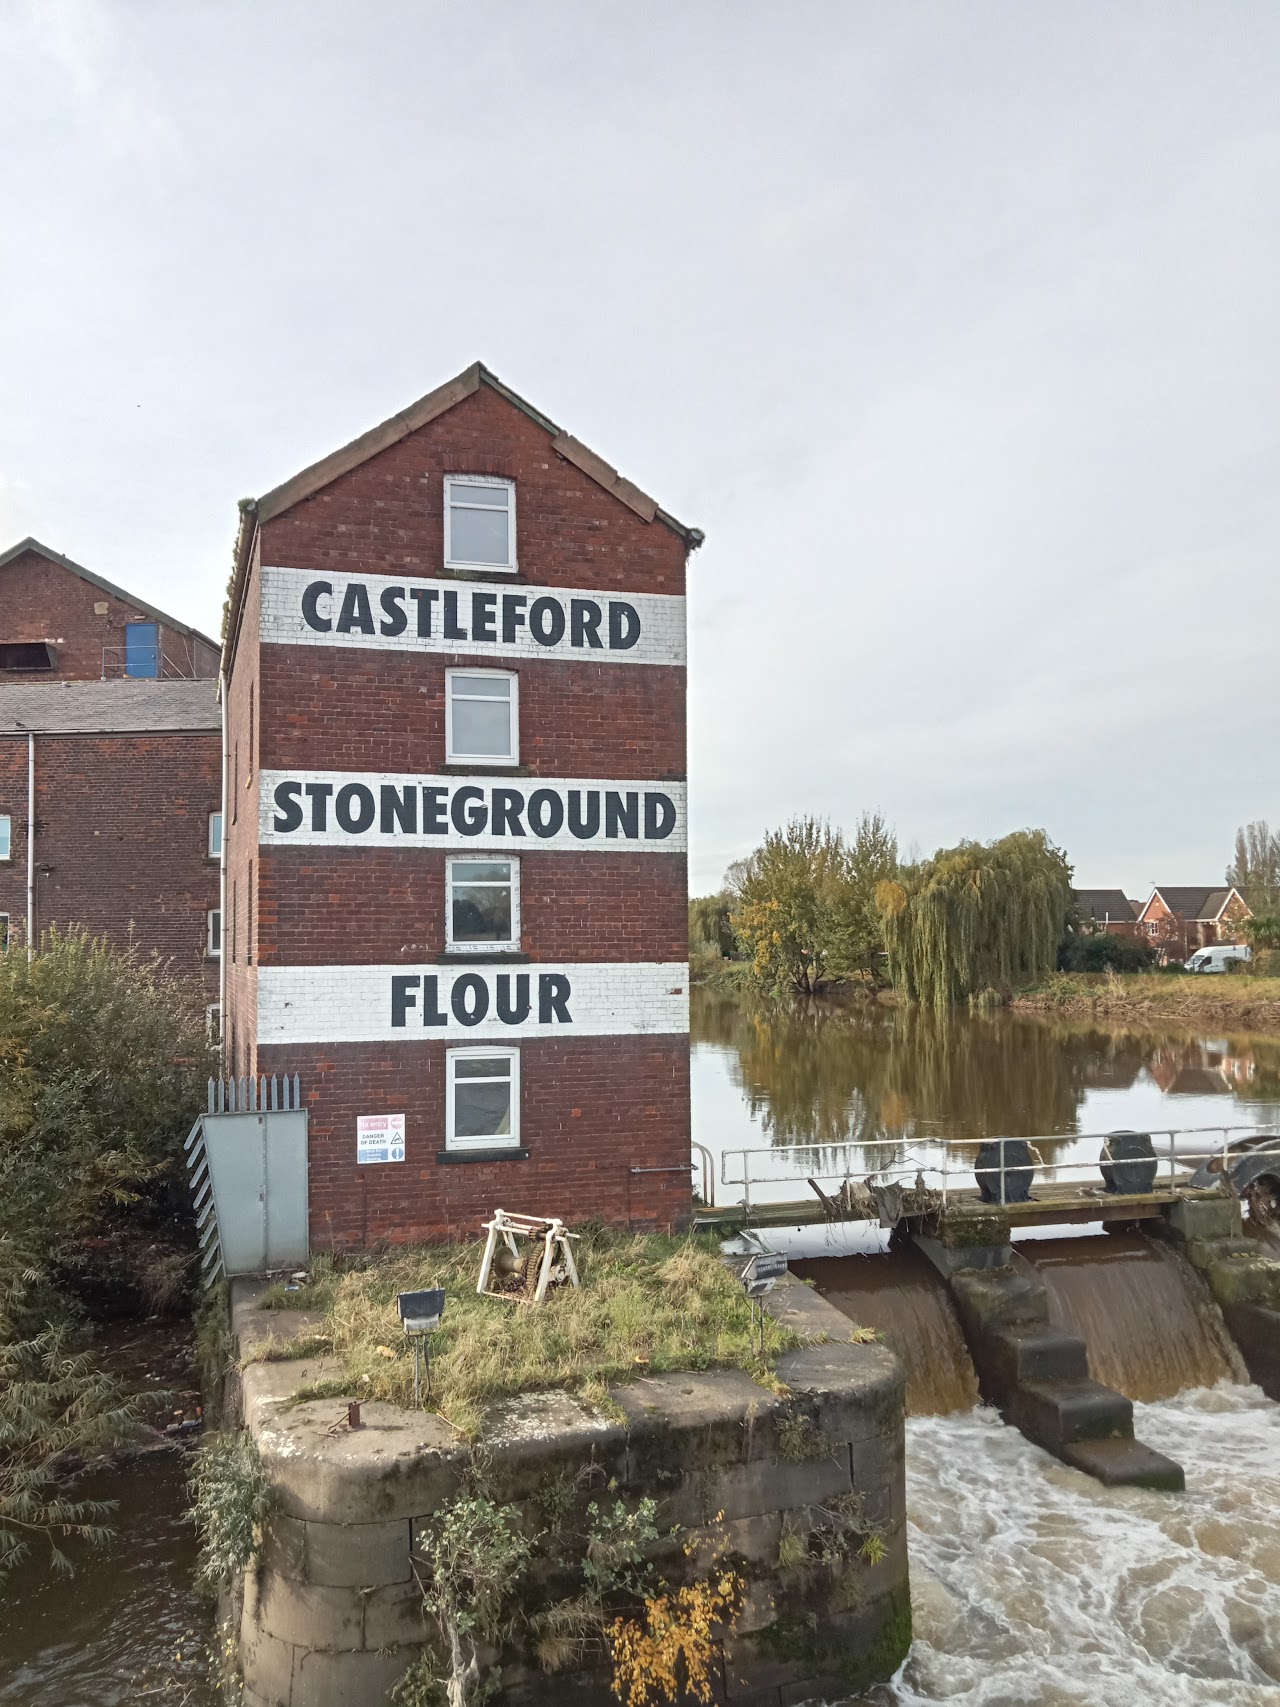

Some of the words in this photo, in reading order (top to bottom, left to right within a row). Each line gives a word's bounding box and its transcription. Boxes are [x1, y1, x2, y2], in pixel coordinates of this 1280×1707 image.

[301, 580, 641, 650] CASTLEFORD
[273, 781, 677, 840] STONEGROUND
[391, 973, 573, 1027] FLOUR
